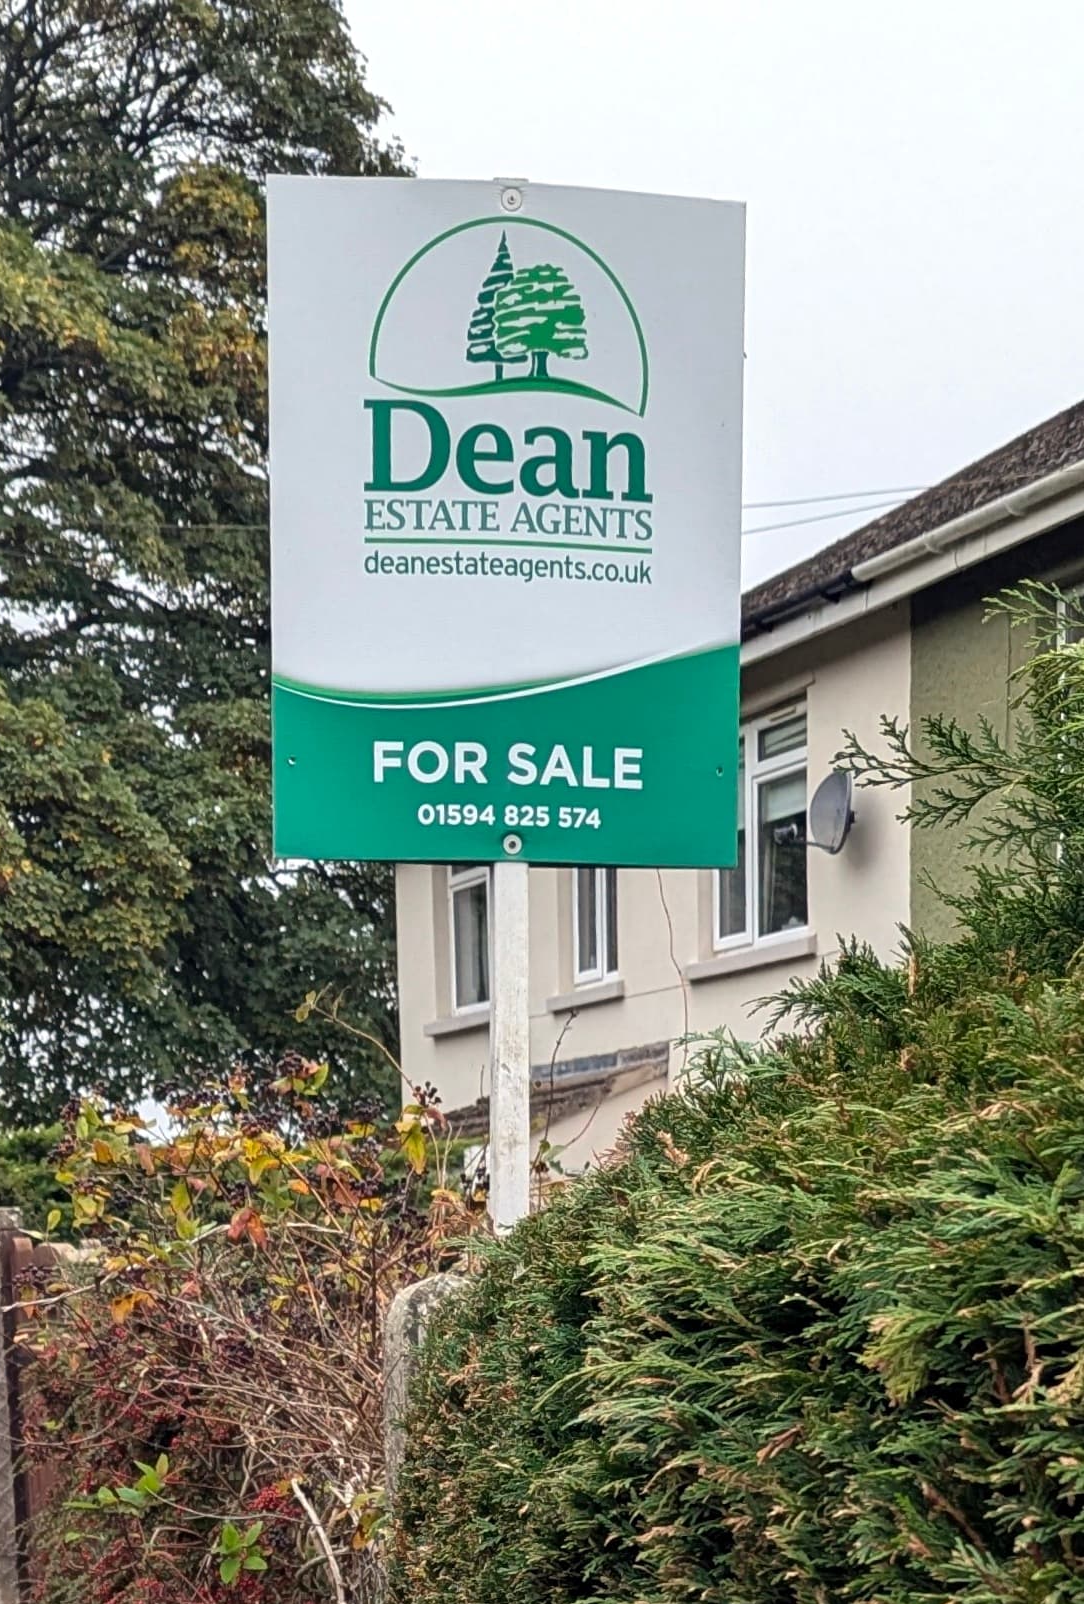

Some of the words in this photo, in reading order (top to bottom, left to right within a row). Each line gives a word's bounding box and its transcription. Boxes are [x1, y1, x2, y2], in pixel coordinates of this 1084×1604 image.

[363, 398, 654, 504] Dean
[363, 498, 501, 533] ESTATE
[510, 501, 653, 541] AGENTS
[363, 550, 652, 585] deanestateagents.co.uk
[373, 740, 488, 784] FOR
[507, 742, 643, 790] SALE
[417, 803, 496, 826] 01594
[504, 804, 550, 828] 825
[558, 806, 601, 829] 574
